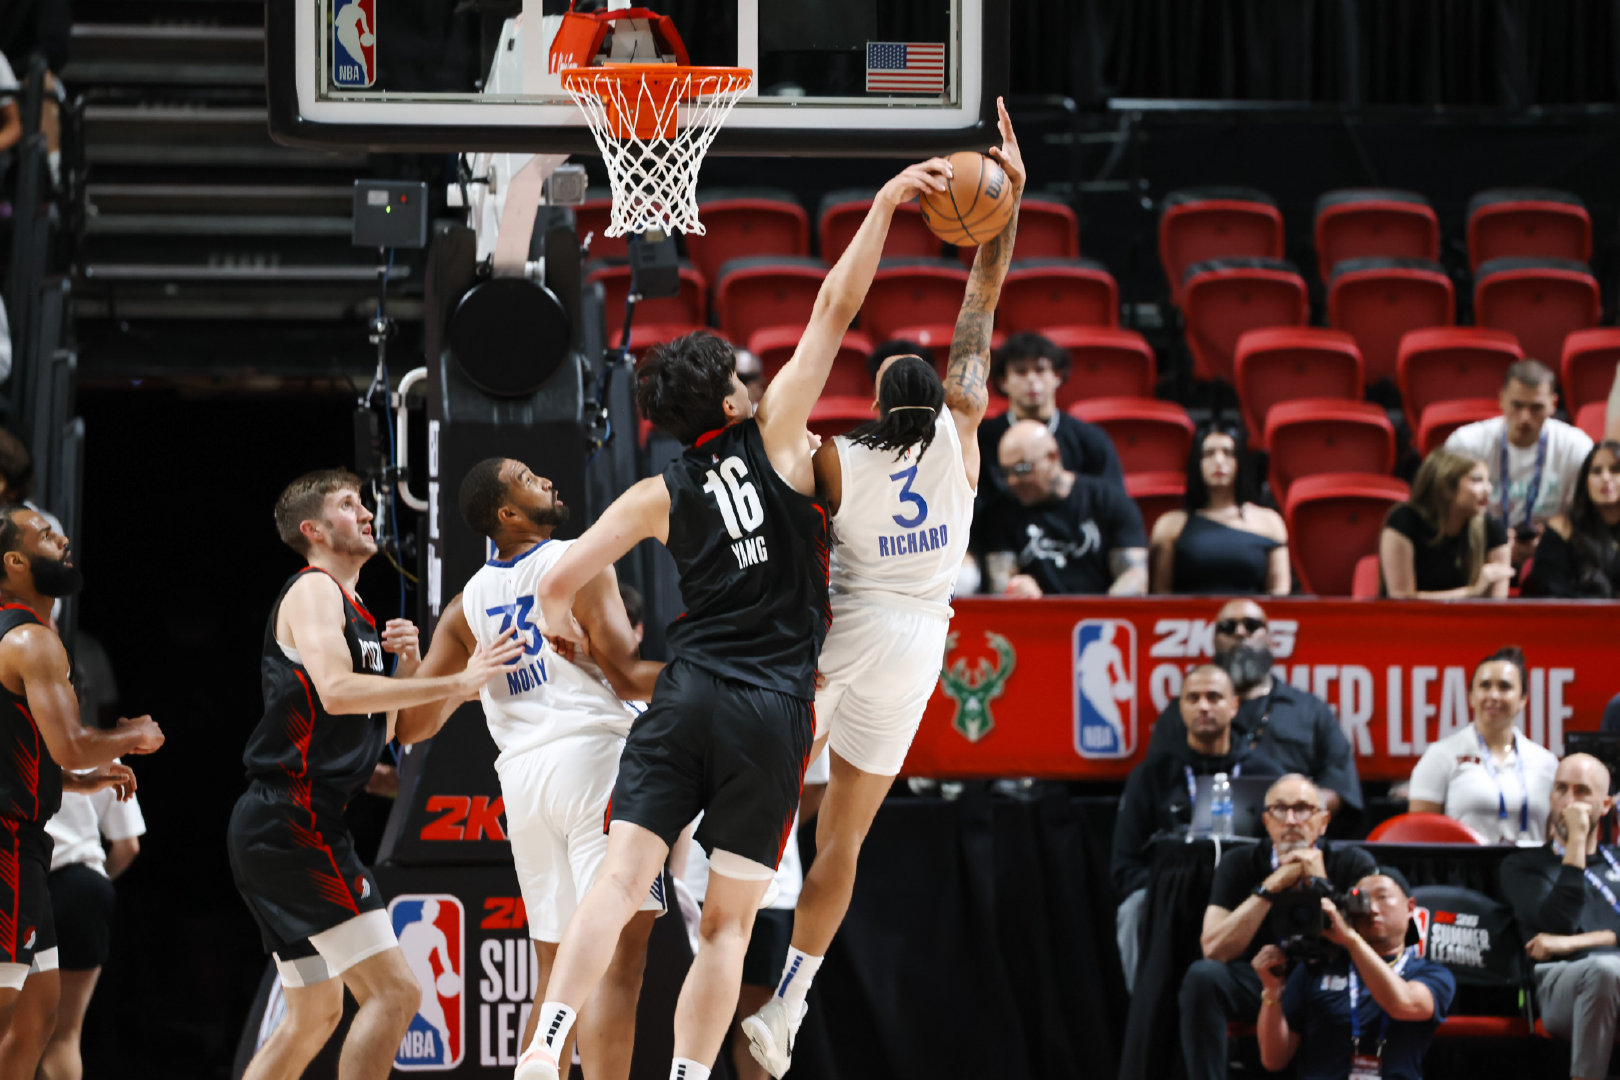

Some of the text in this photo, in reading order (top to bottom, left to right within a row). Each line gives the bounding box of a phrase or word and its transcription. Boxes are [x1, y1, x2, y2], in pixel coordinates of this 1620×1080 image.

[339, 64, 361, 81] NBA
[703, 456, 764, 540] 16
[889, 465, 928, 528] 3
[731, 535, 768, 570] YANG
[878, 524, 948, 557] RICHARD
[1431, 923, 1490, 952] SUMMER
[399, 1030, 436, 1059] NBA
